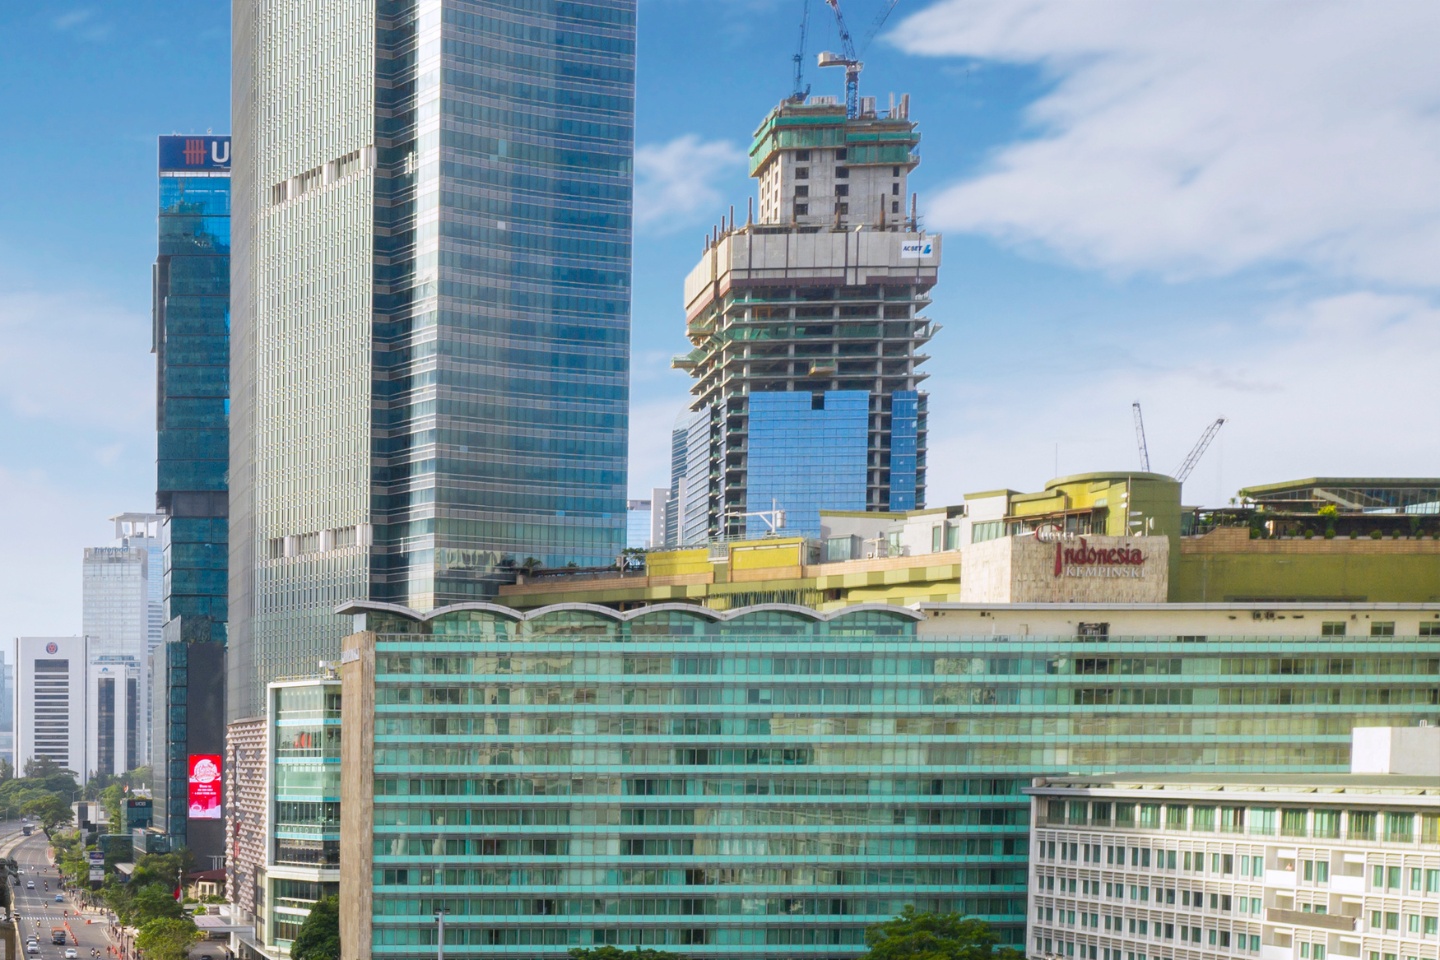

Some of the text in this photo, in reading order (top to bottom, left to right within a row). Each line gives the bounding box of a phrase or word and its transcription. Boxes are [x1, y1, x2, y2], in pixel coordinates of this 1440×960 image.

[1041, 531, 1075, 541] HOTEL
[1054, 536, 1148, 578] Indonesia
[1066, 566, 1146, 578] KEMPINSKI
